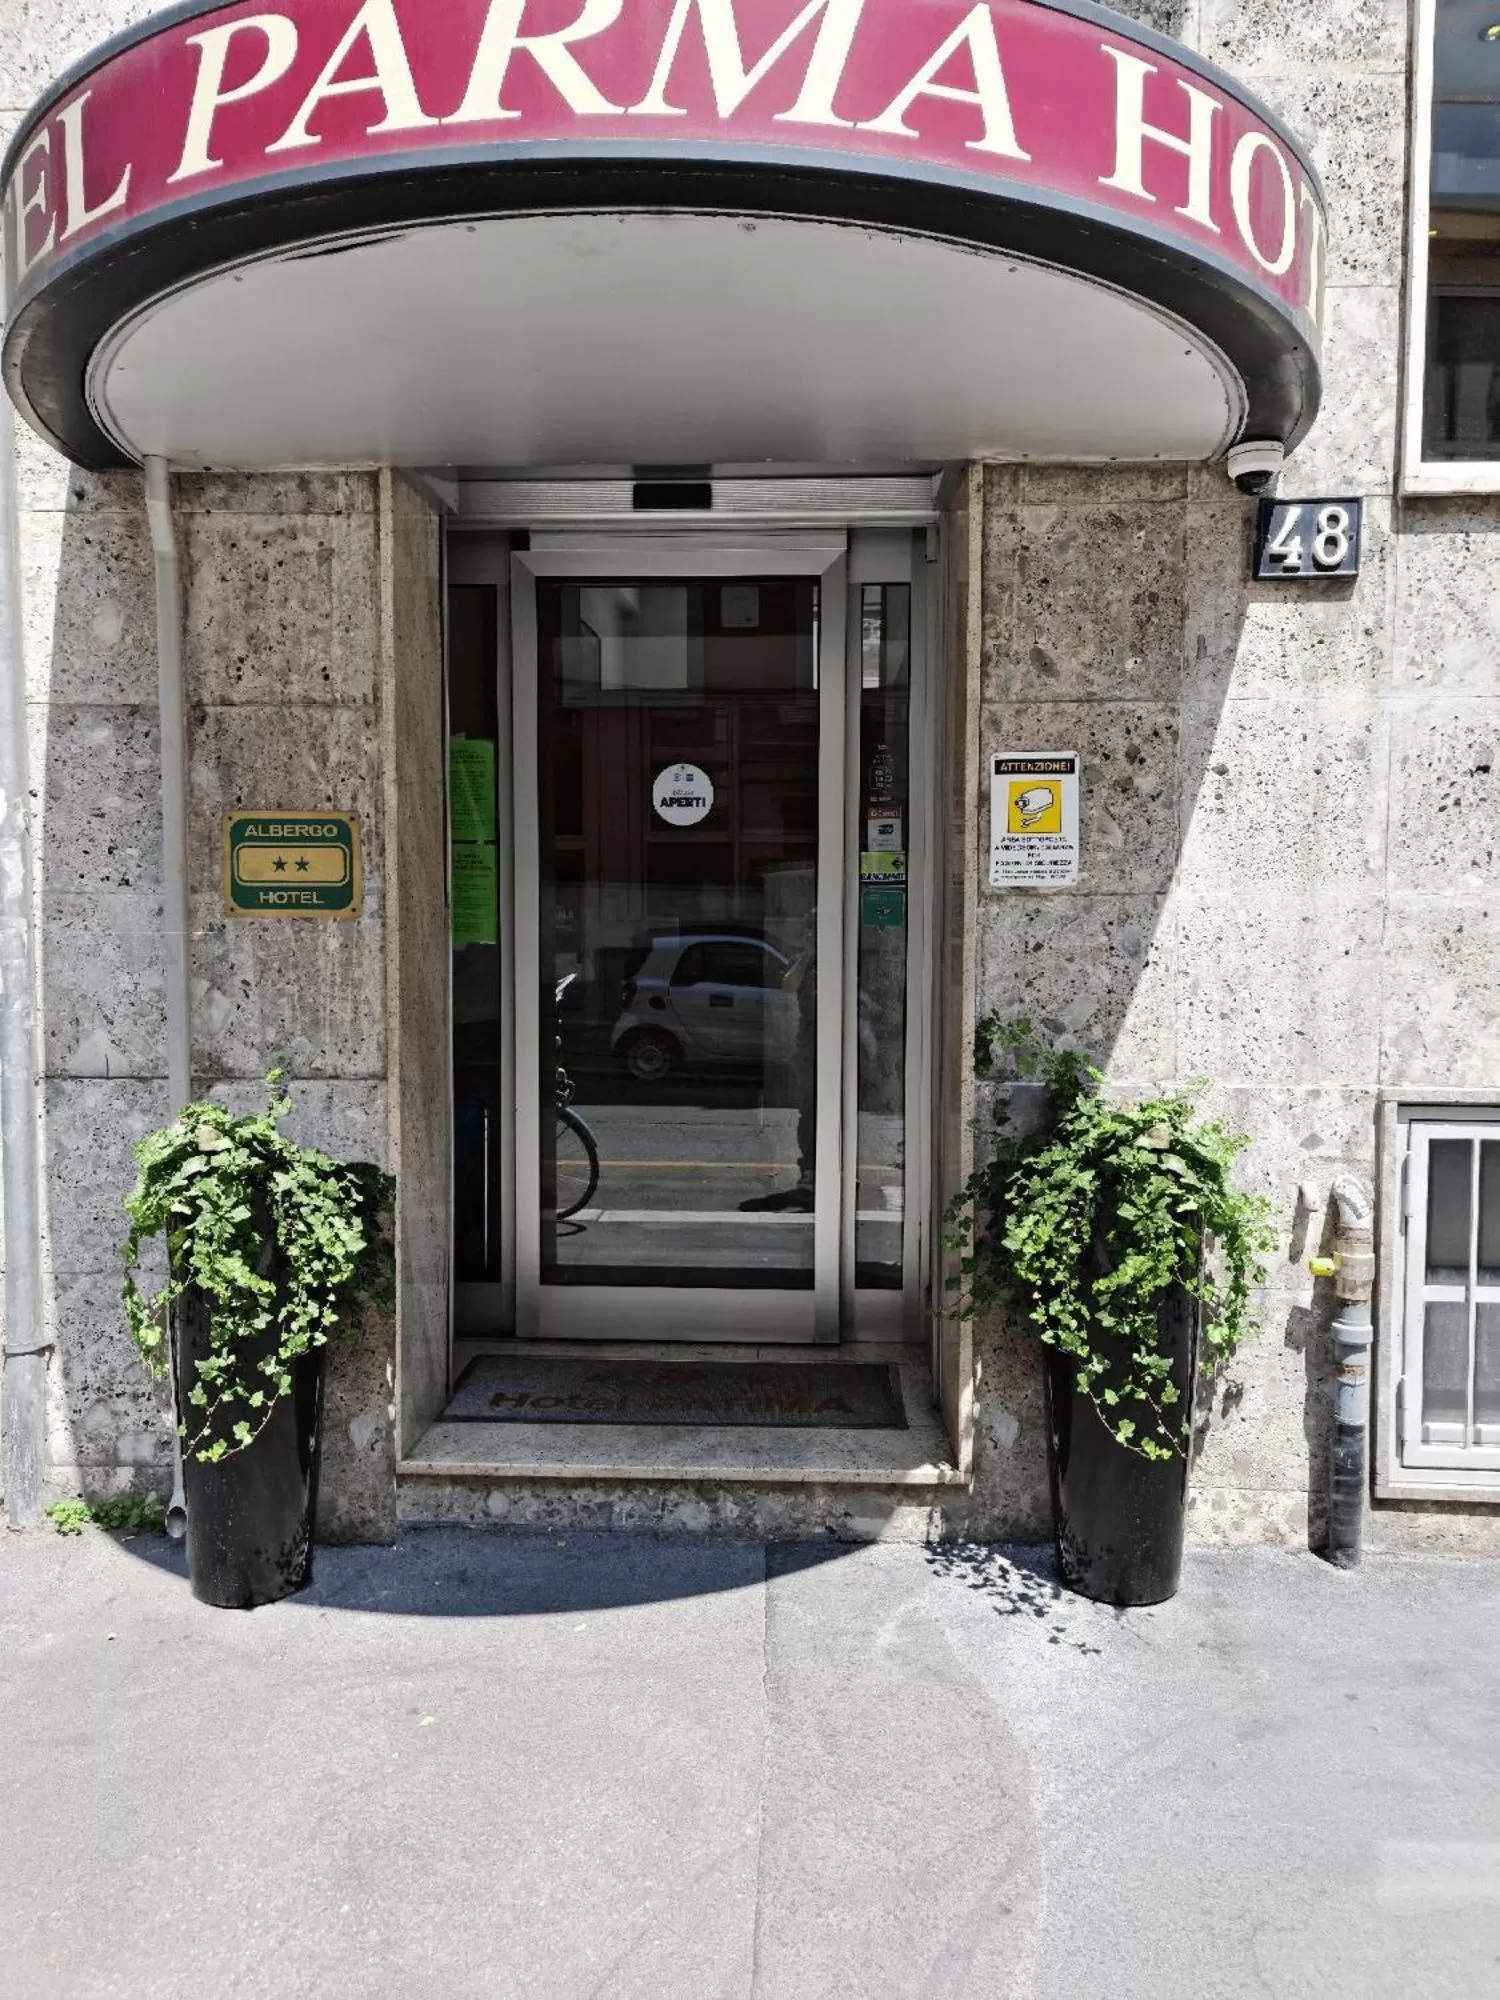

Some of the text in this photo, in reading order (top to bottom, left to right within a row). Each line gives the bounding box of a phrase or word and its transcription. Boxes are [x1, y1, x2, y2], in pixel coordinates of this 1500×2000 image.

[168, 0, 1031, 184] PARMA
[1269, 505, 1350, 567] 48
[1000, 761, 1071, 772] ATTENZIONE!
[660, 796, 706, 807] APERTI
[244, 824, 338, 837] ALBERGO
[259, 891, 325, 904] HOTEL
